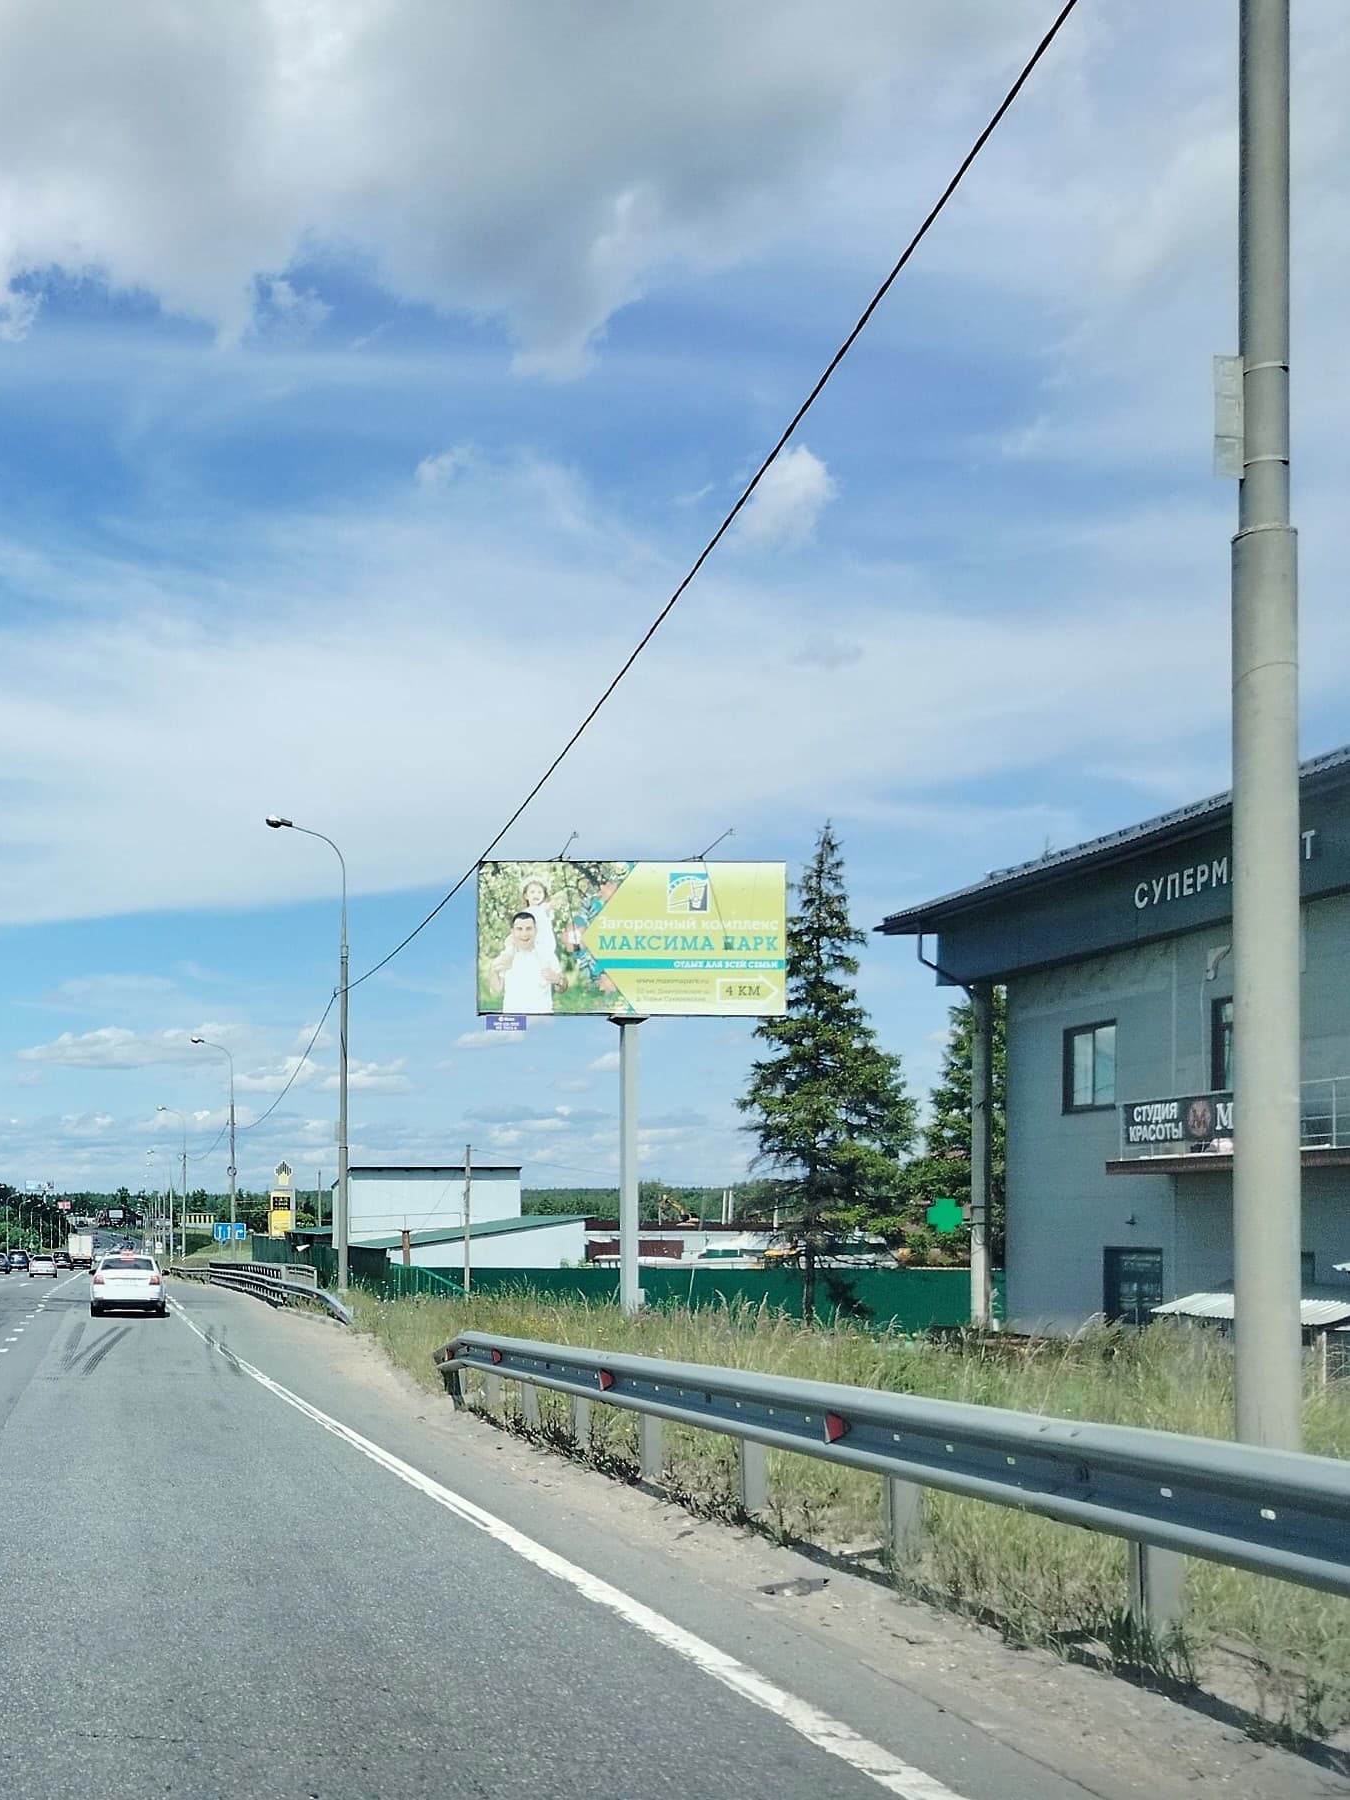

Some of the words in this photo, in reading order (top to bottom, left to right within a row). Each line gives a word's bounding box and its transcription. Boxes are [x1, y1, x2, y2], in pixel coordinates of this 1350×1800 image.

[1134, 829, 1316, 909] СУПЕРМТ
[598, 916, 696, 931] Загородный
[700, 918, 779, 931] комплекс
[598, 935, 715, 951] МАКСИМА
[722, 935, 779, 951] ПАРК
[725, 985, 734, 996] 4
[737, 985, 761, 996] КМ
[1133, 1102, 1178, 1123] СТУДИЯ
[1129, 1121, 1183, 1142] КРАСОТЫ
